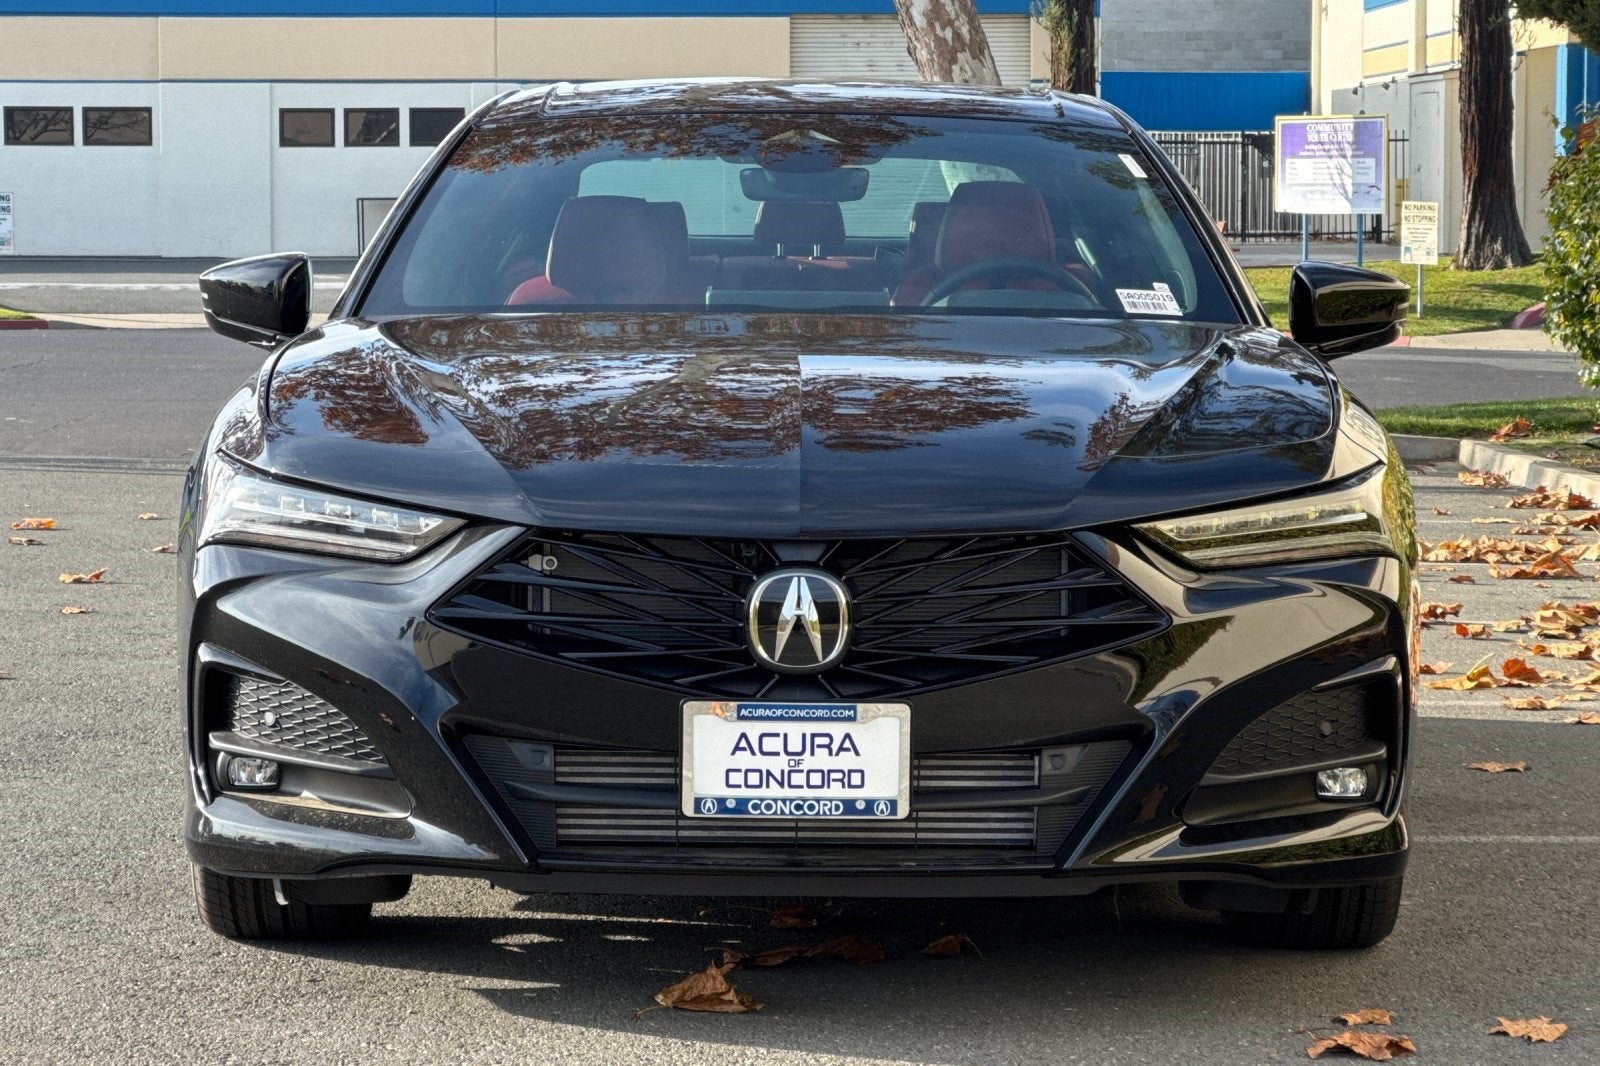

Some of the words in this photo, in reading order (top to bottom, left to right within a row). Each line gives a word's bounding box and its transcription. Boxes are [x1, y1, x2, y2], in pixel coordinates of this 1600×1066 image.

[1307, 124, 1354, 132] COMMUNITY
[1413, 204, 1436, 212] PARKING
[1412, 215, 1436, 223] STOPPING
[1120, 292, 1174, 302] SA005019
[740, 708, 854, 718] ACURAOFCONCORD.COM
[730, 732, 861, 757] ACURA
[787, 758, 805, 768] OF
[725, 768, 865, 789] CONCORD
[747, 799, 843, 815] CONCORD
